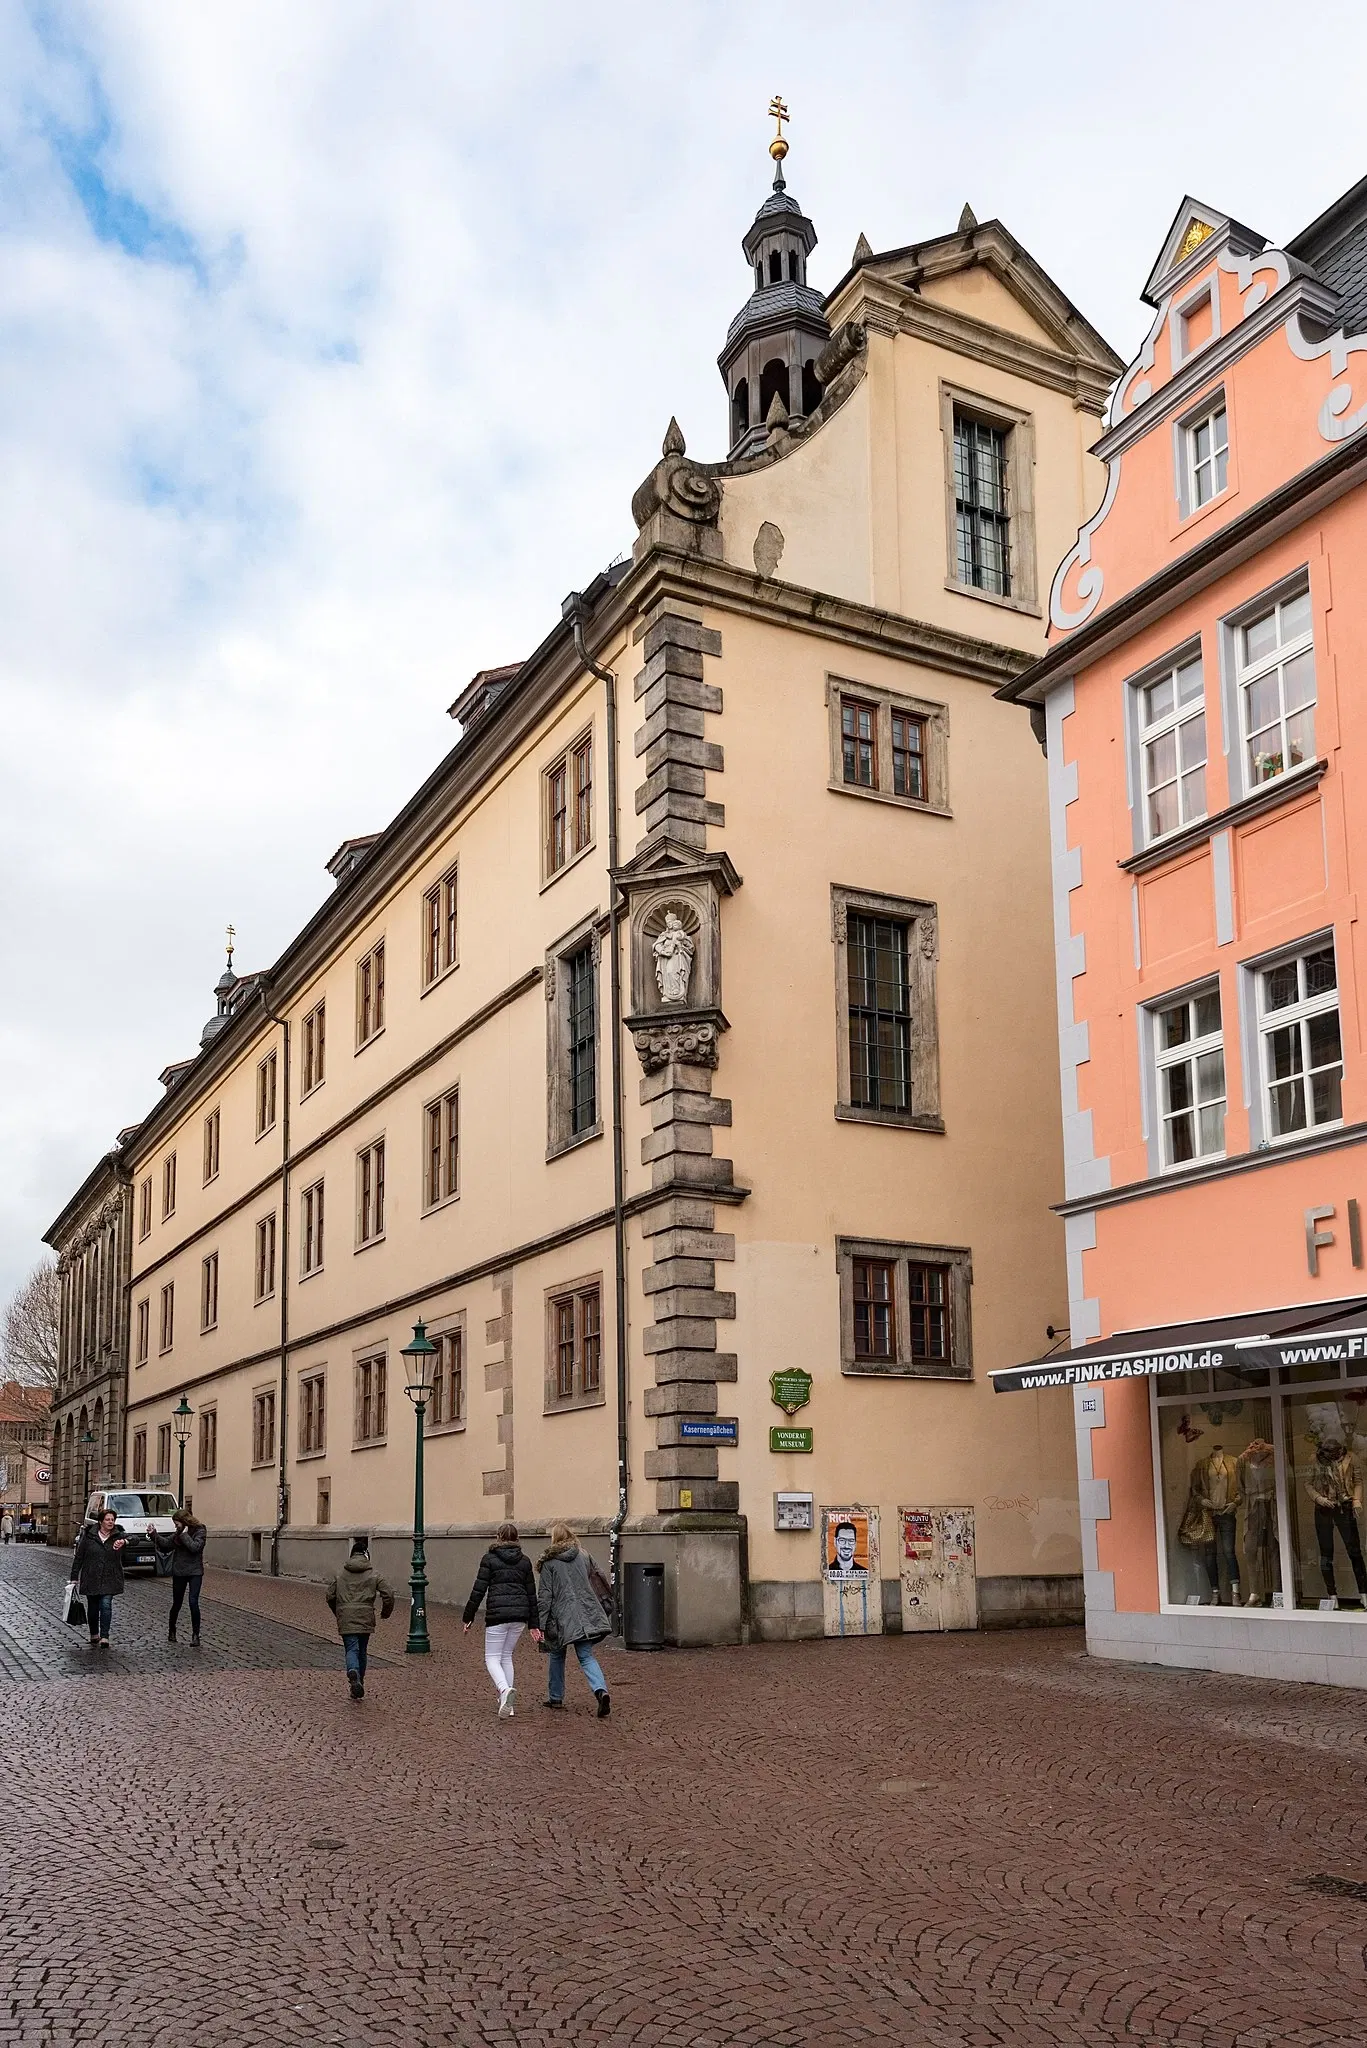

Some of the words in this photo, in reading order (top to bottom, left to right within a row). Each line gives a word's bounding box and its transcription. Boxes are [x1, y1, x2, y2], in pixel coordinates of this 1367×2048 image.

[1304, 1199, 1362, 1276] FI
[1021, 1350, 1223, 1389] www.FINK-FASHION.de
[683, 1425, 734, 1435] Kasernengäßchen
[779, 1440, 805, 1448] MUSEUM
[829, 1513, 852, 1523] RICK
